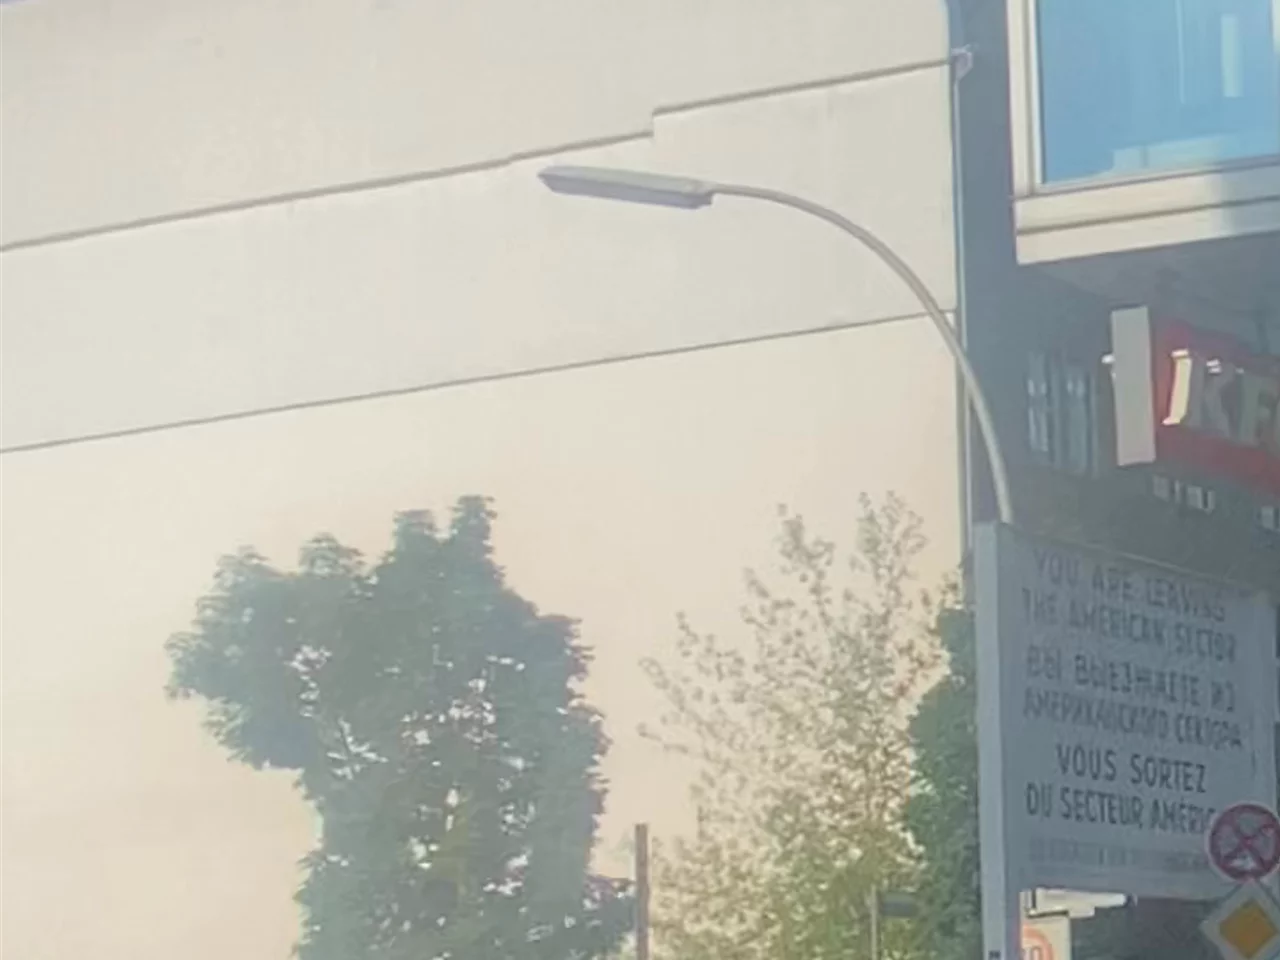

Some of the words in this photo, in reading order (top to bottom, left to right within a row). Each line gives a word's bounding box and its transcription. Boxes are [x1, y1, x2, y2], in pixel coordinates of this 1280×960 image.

[1033, 549, 1078, 588] YOU
[1092, 565, 1134, 600] ARE
[1022, 587, 1057, 625] THE
[1068, 600, 1165, 646] AMERICAN
[1175, 622, 1237, 664] SECTOR
[1056, 744, 1117, 782] VOUS
[1130, 753, 1207, 794] SORTEZ
[1026, 782, 1052, 818] DU
[1060, 786, 1145, 828] SECTEUR
